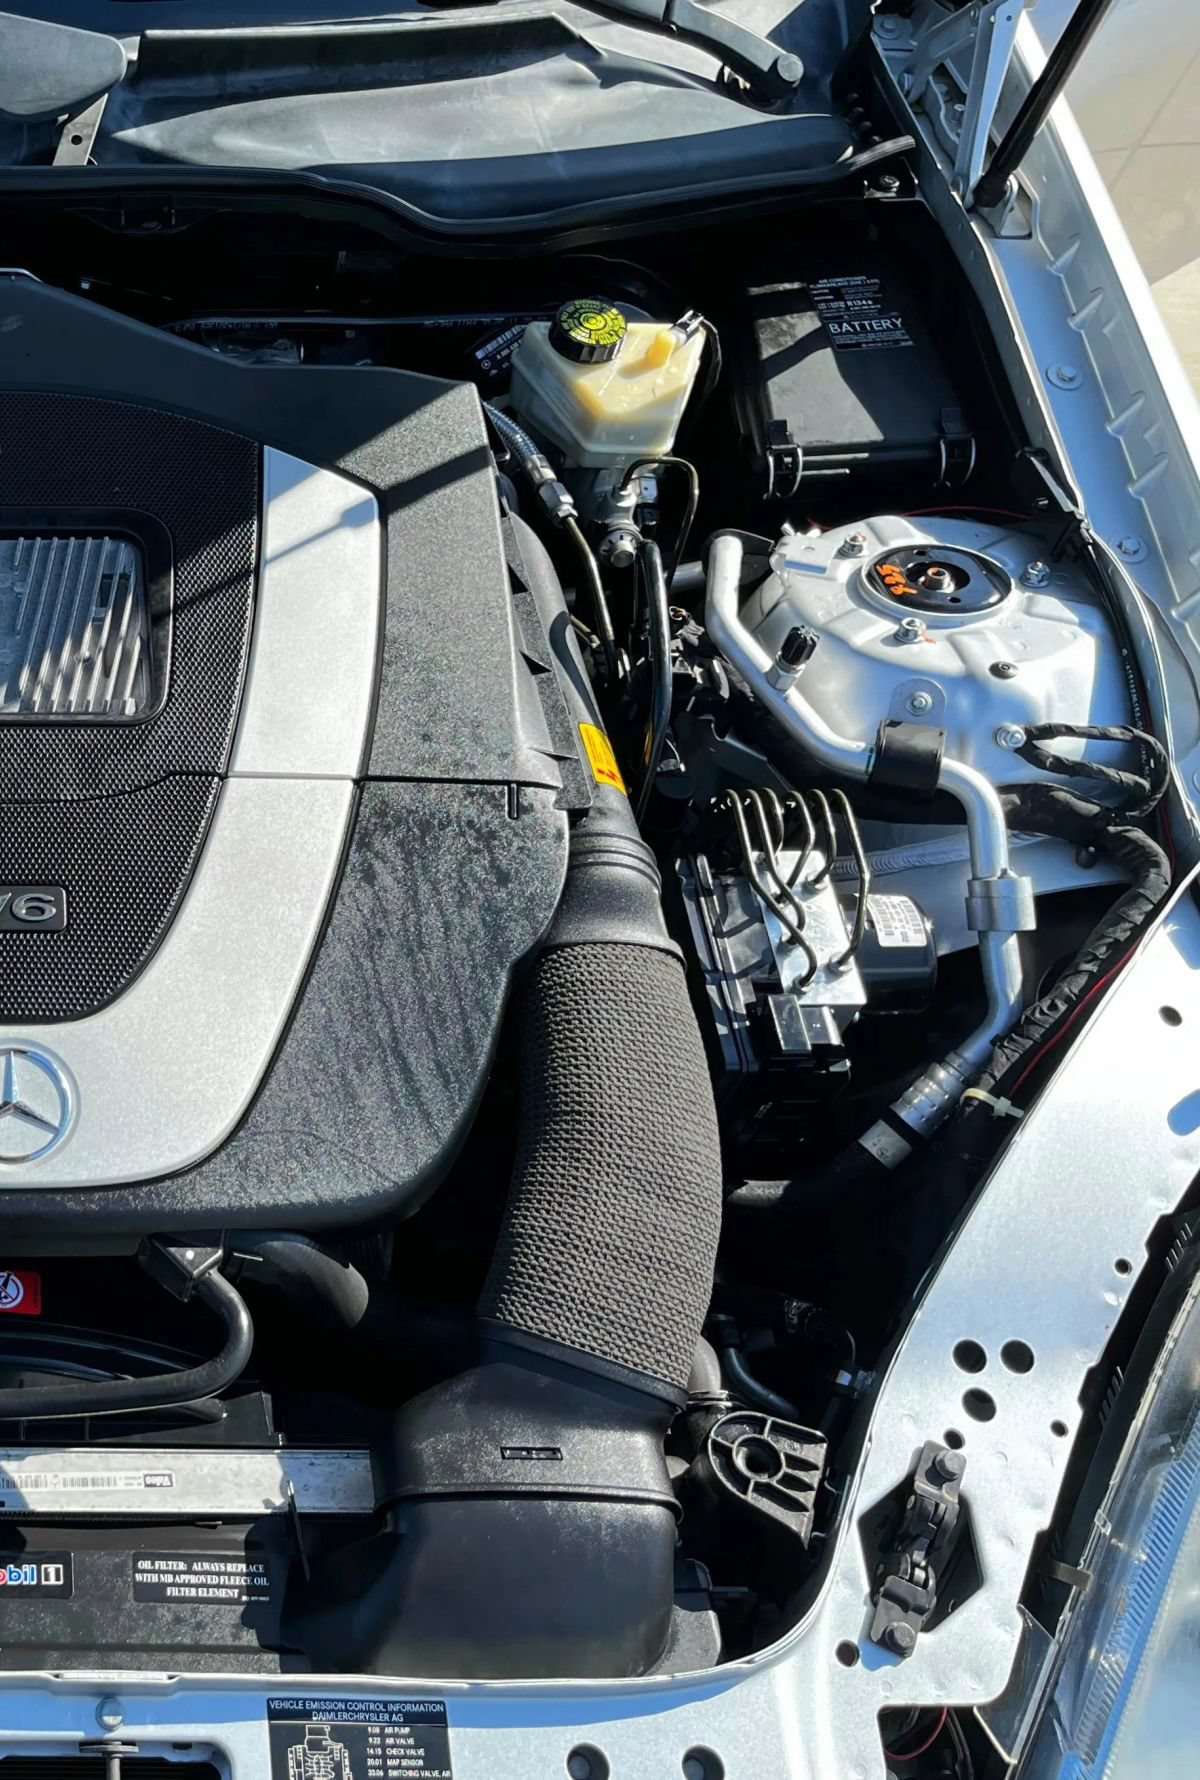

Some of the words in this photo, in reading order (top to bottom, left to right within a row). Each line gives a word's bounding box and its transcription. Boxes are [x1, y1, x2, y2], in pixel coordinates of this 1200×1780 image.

[828, 318, 902, 333] BATTERY
[138, 1561, 153, 1570] OIL
[155, 1561, 187, 1570] FILTER:
[192, 1562, 224, 1572] ALWAYS
[227, 1563, 264, 1573] REPLACE
[44, 1566, 58, 1584] 1
[135, 1574, 158, 1582] WITH
[160, 1574, 173, 1583] MB
[174, 1574, 219, 1584] APPROVED
[220, 1576, 253, 1585] FLEECE
[254, 1577, 269, 1586] OIL
[166, 1587, 197, 1597] FILTER
[198, 1588, 239, 1598] ELEMENT
[269, 1700, 304, 1709] VEHICLE
[306, 1701, 345, 1710] EMISSION
[347, 1701, 385, 1711] CONTROL
[387, 1702, 444, 1712] INFORMATION
[312, 1712, 391, 1722] DAIMLERCHRYSLER
[392, 1713, 404, 1722] AG
